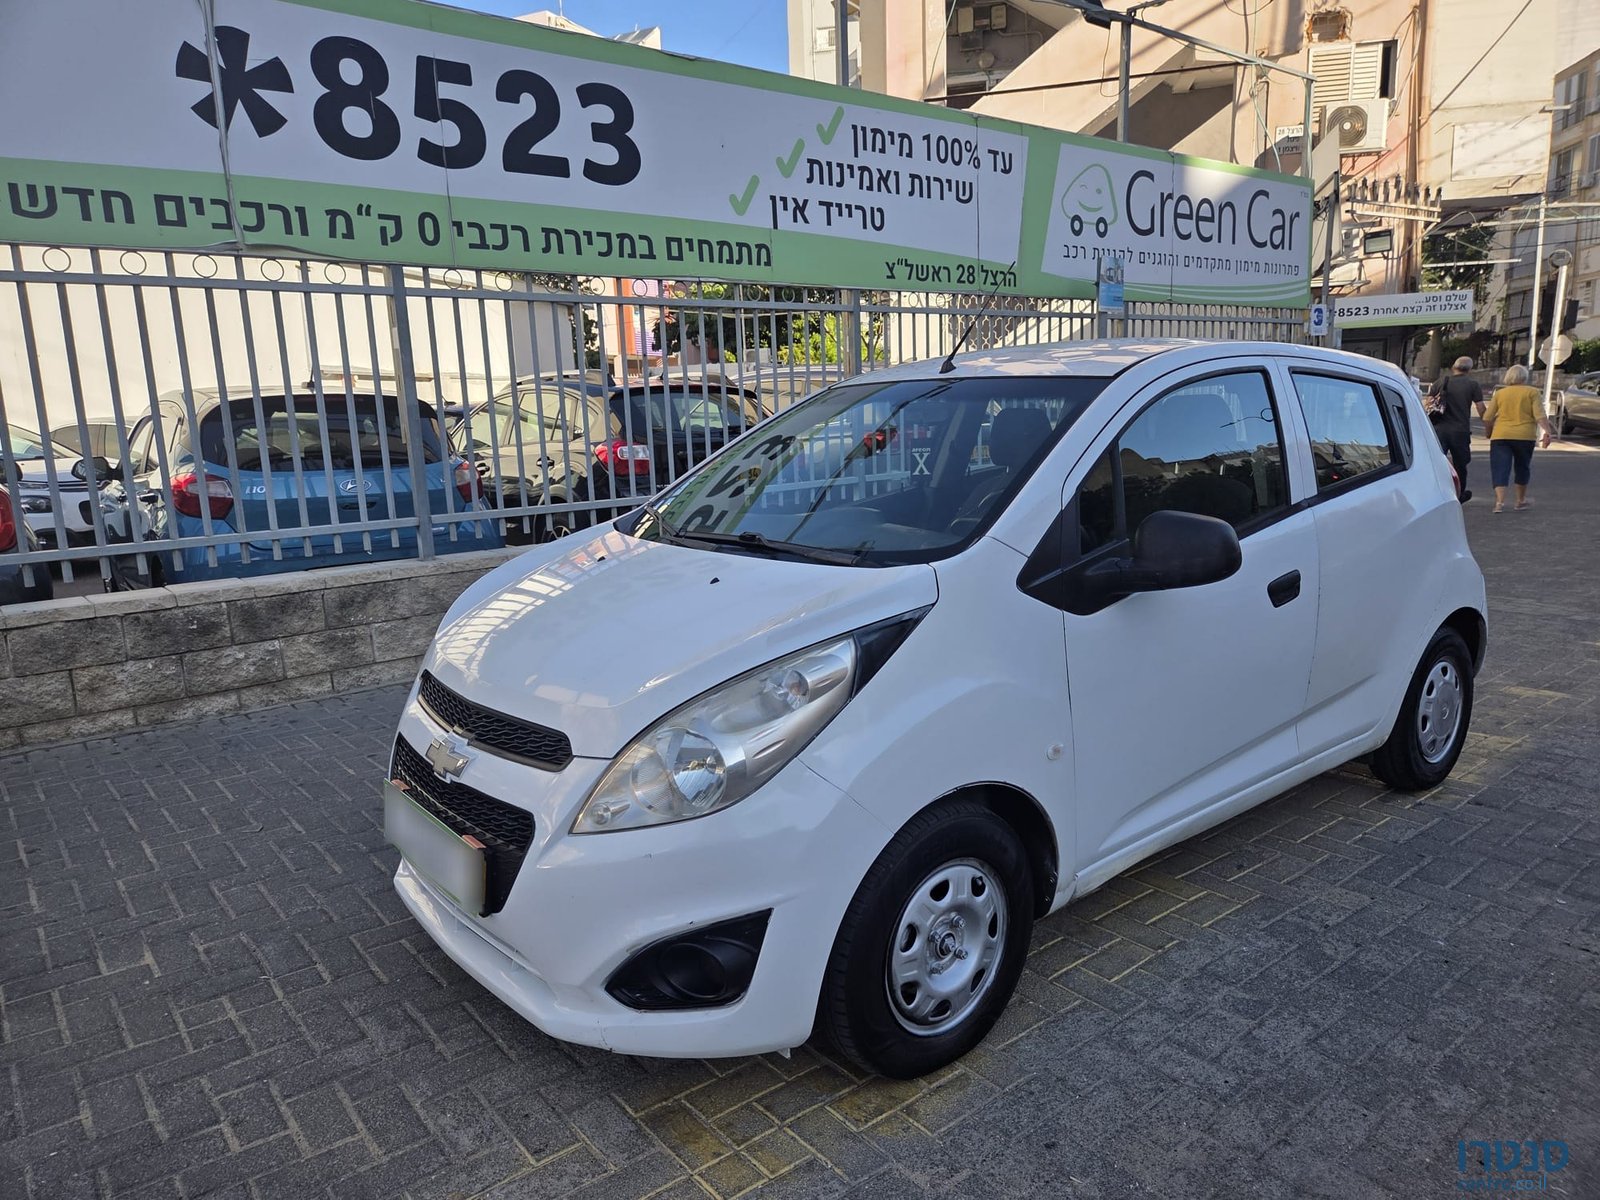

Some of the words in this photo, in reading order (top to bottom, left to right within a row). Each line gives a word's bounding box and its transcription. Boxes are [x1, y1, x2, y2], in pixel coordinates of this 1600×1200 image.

[851, 124, 913, 158] מימון
[921, 133, 981, 170] 100%
[987, 149, 1013, 175] עד
[806, 158, 900, 195] ואמינות
[908, 173, 974, 204] שירות
[3, 182, 136, 224] חדש
[153, 193, 310, 237] ורכבים
[769, 195, 810, 230] אין
[818, 200, 885, 232] טרייד
[1125, 169, 1236, 245] Green
[1246, 189, 1300, 251] Car
[417, 211, 441, 247] 0
[451, 220, 531, 252] רכבי
[541, 226, 657, 260] במכירת
[665, 236, 772, 267] מתמחים
[1062, 243, 1087, 260] רכב
[1138, 251, 1179, 268] והוגנים
[1183, 254, 1231, 273] מתקדמים
[1235, 259, 1261, 275] מימון
[1263, 262, 1300, 277] פתרונות
[955, 263, 976, 285] 28
[980, 264, 1017, 288] הרצל
[1401, 305, 1423, 316] קצת
[1425, 304, 1436, 313] זה
[1439, 301, 1467, 312] אצלנו
[1445, 293, 1468, 302] שלם
[1372, 307, 1400, 316] אחרת
[911, 452, 932, 476] X
